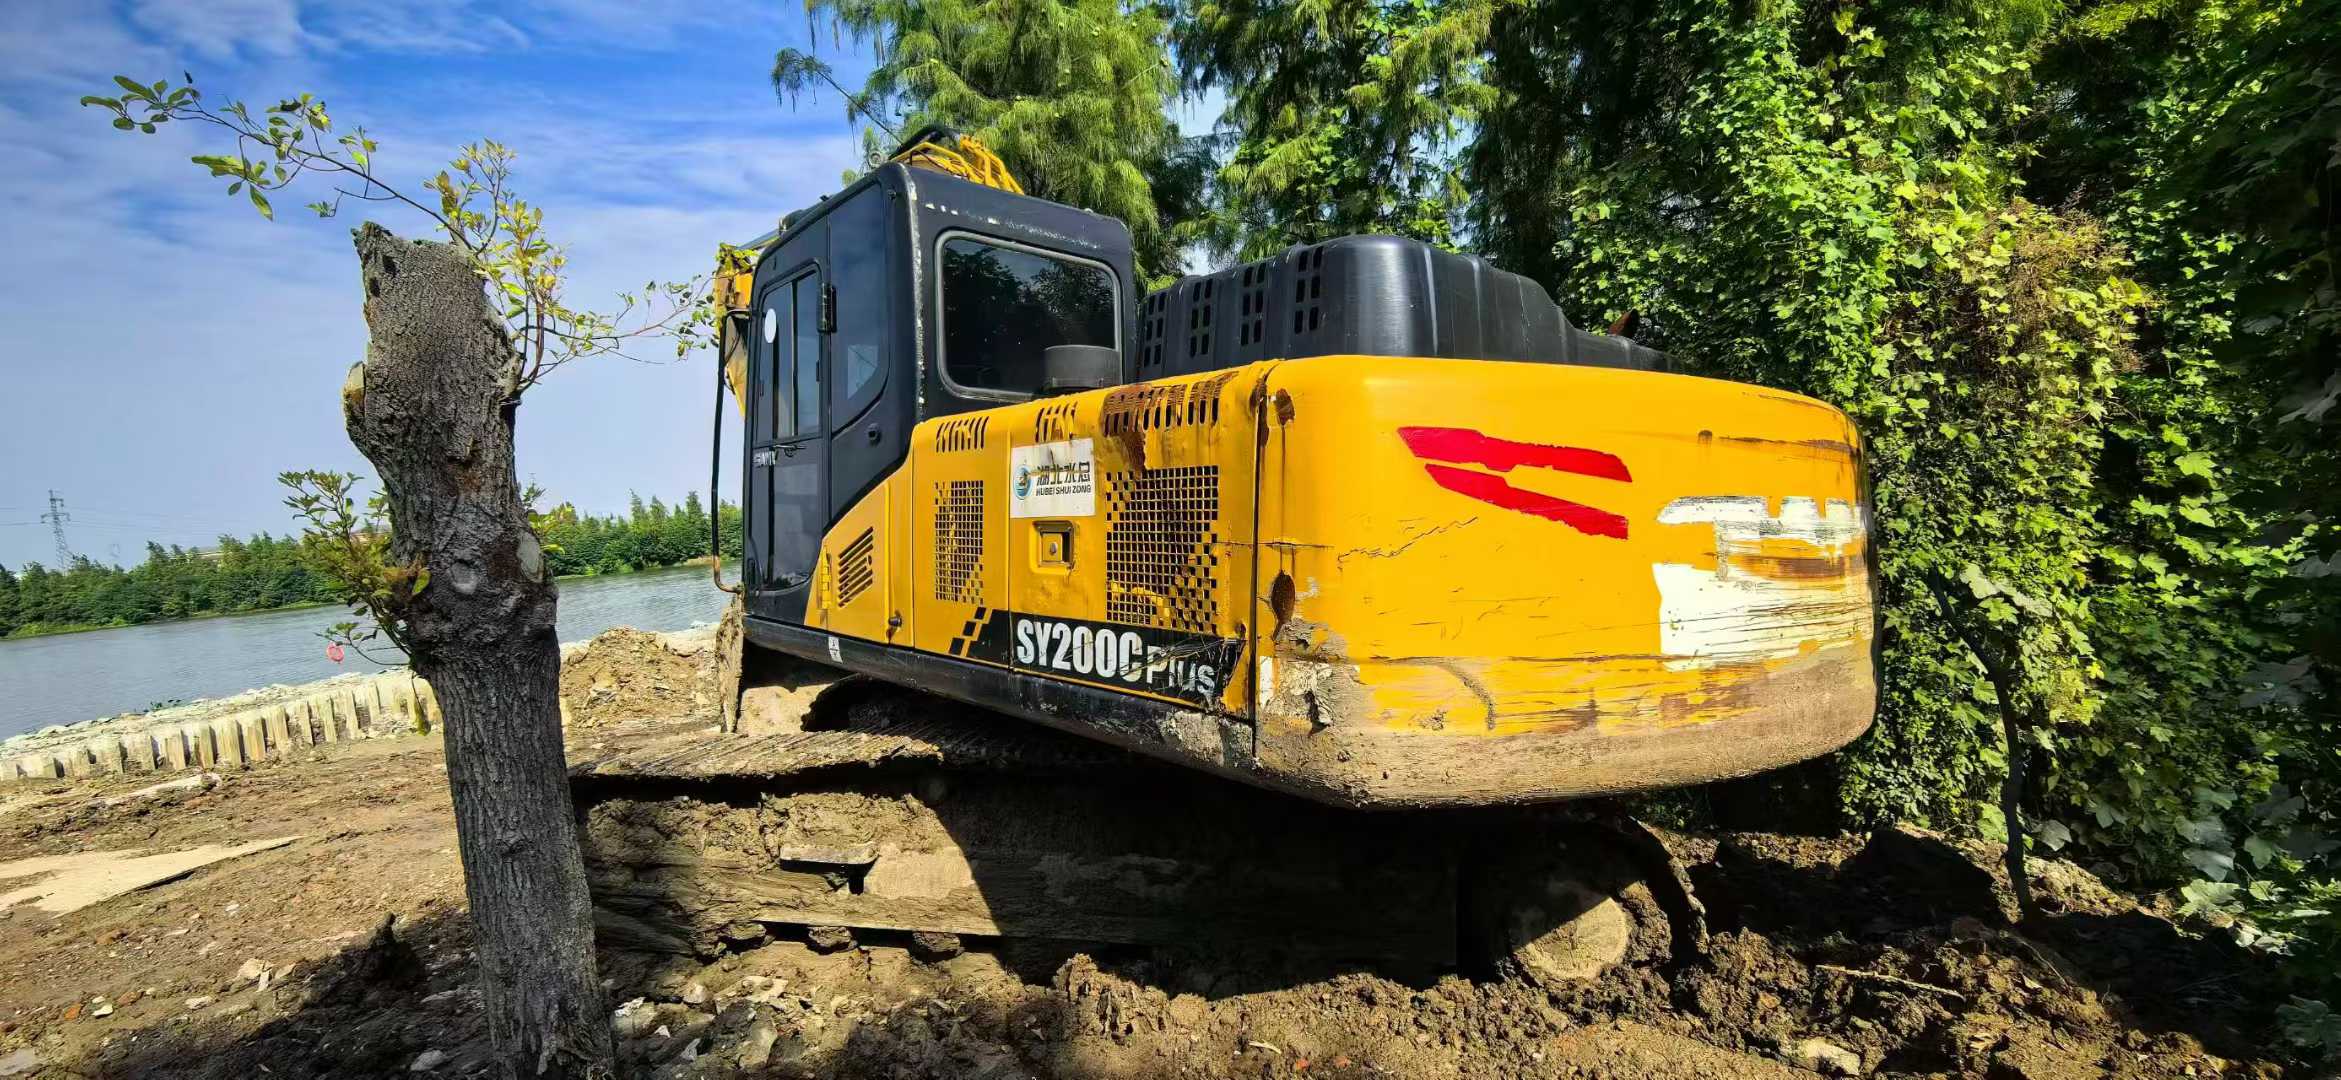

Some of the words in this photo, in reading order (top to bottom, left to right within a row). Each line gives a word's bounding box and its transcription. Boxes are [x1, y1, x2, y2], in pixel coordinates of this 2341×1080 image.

[1036, 487, 1055, 497] HUBEI
[1056, 486, 1071, 495] SHUI
[1072, 484, 1091, 494] ZONG
